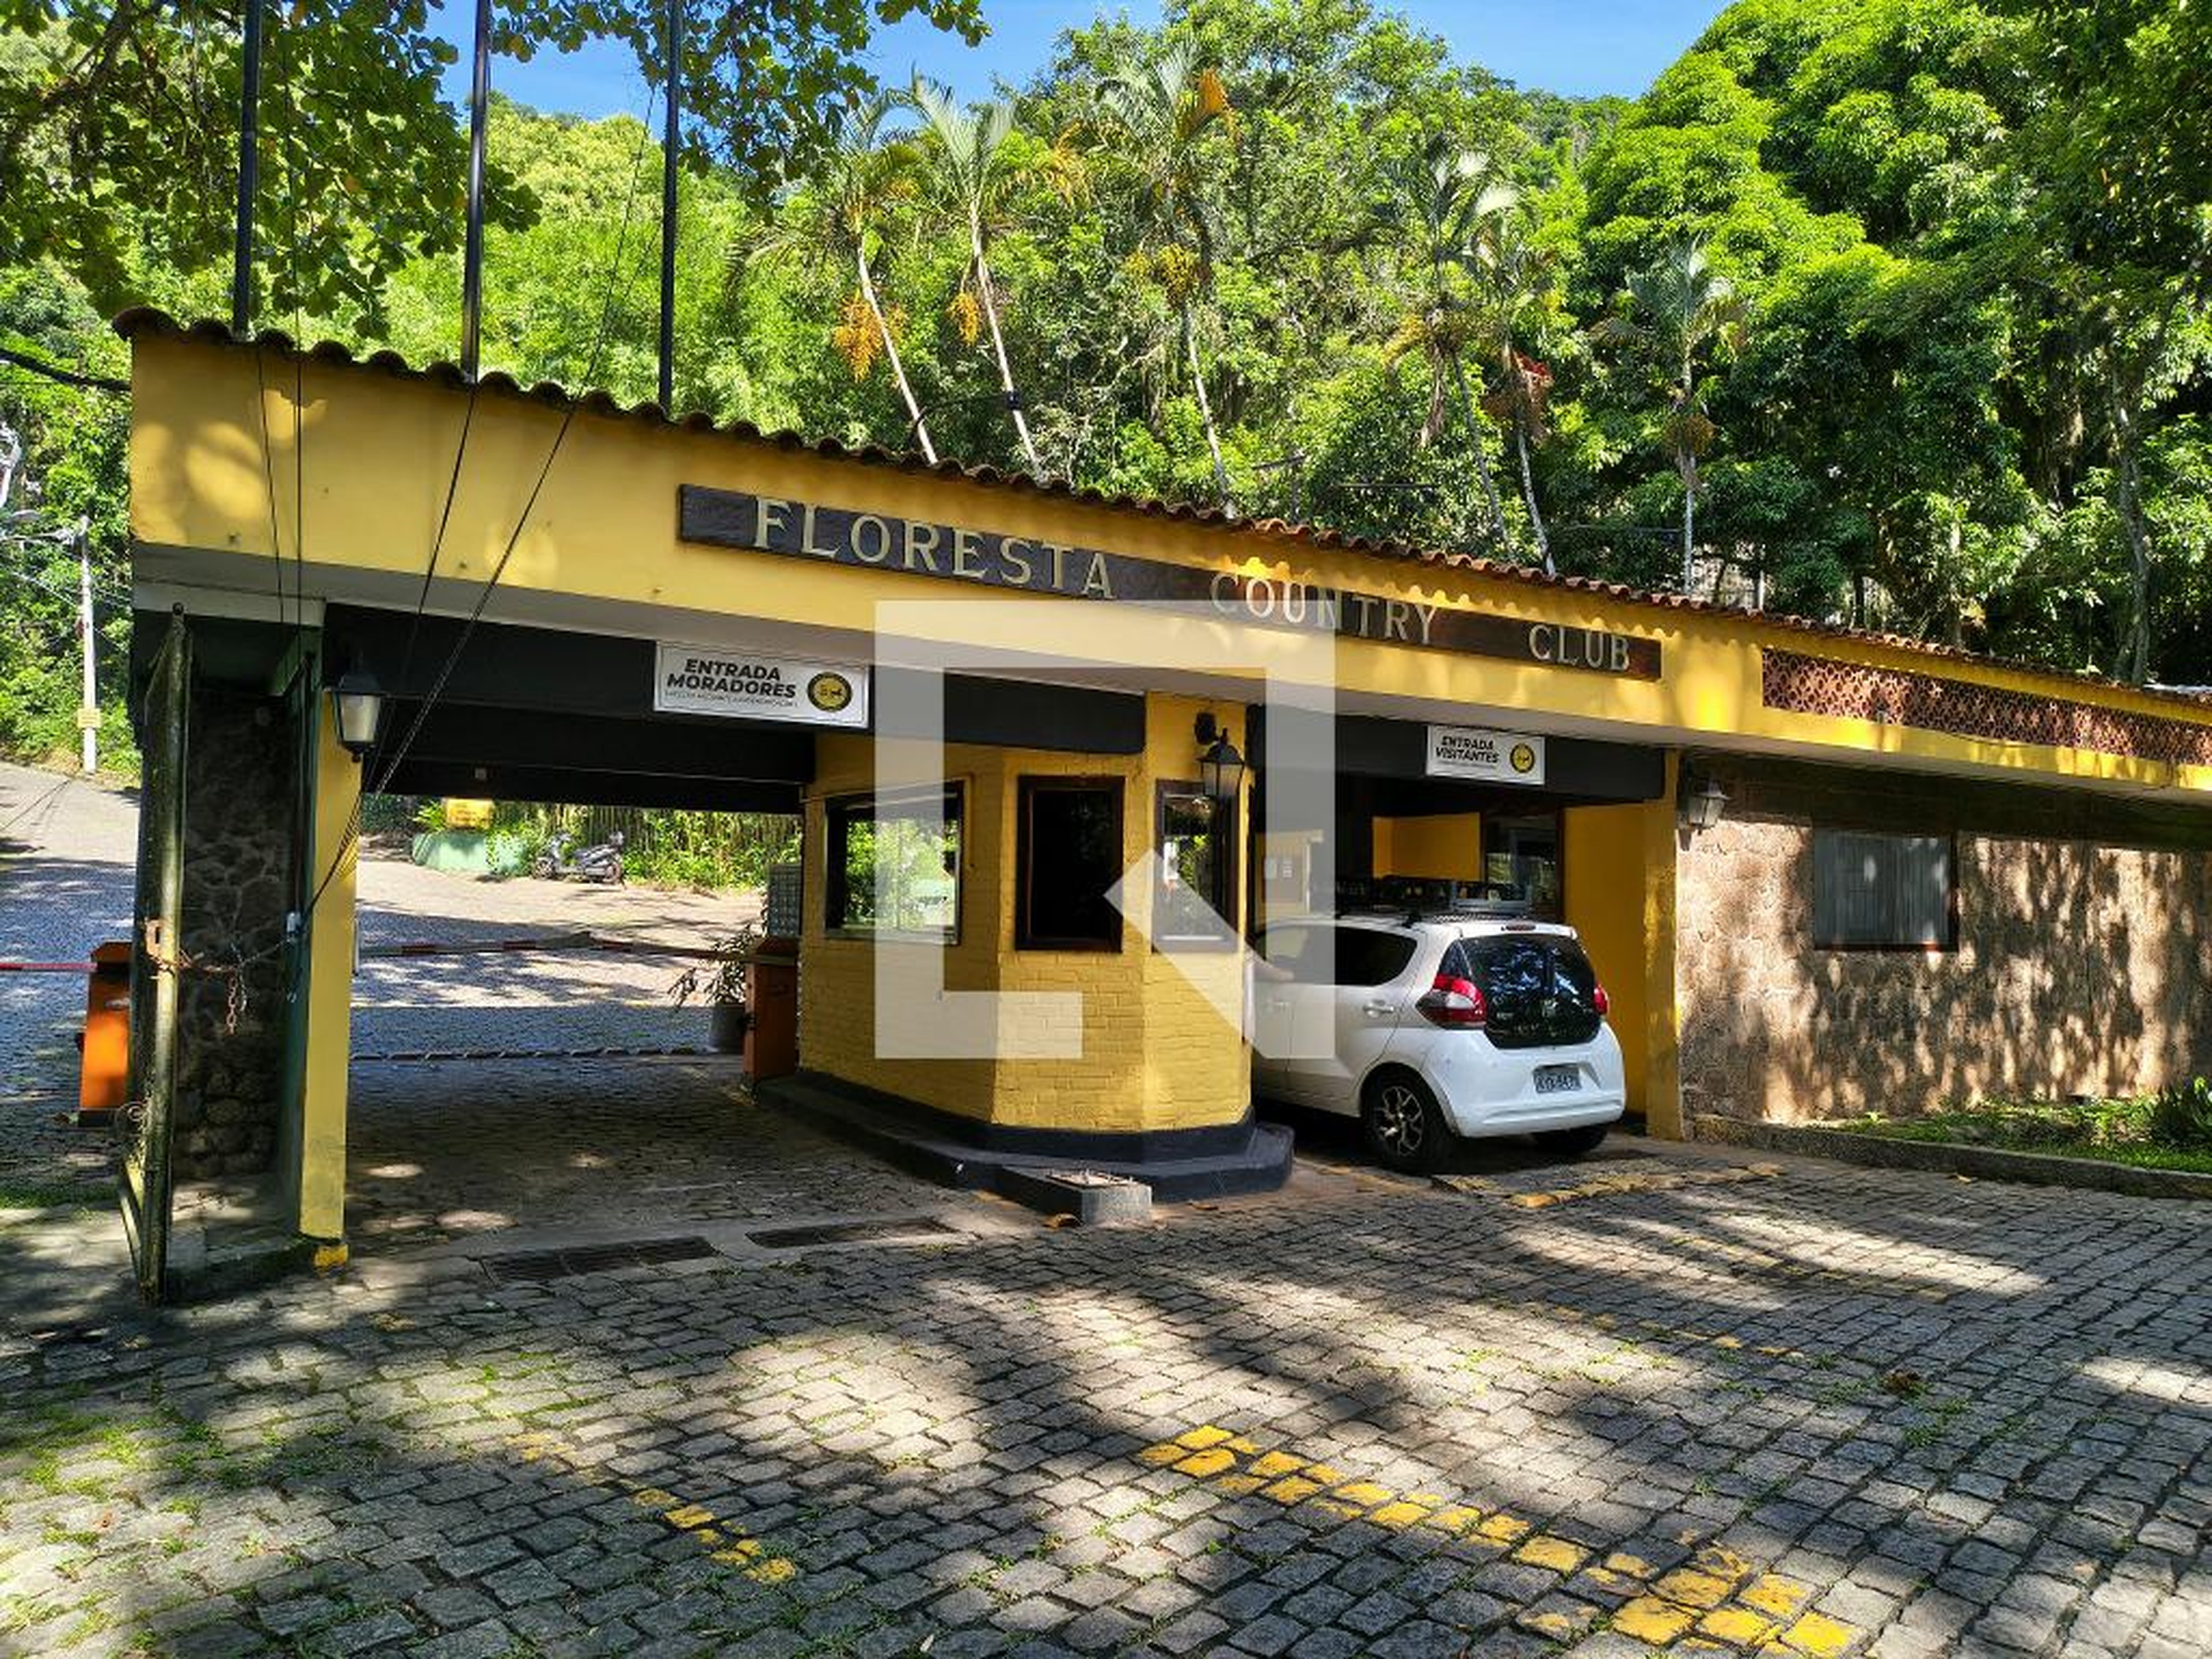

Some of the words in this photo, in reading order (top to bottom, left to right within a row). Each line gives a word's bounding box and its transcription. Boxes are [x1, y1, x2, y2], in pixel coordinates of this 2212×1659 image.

[753, 497, 1117, 599] FLORESTA
[1210, 574, 1438, 645] COUNTRY
[1528, 624, 1630, 671] CLUB
[684, 659, 781, 680] ENTRADA
[667, 673, 796, 698] MORADORES
[1441, 736, 1493, 750] ENTRADA
[1435, 747, 1499, 763] VISITANTES
